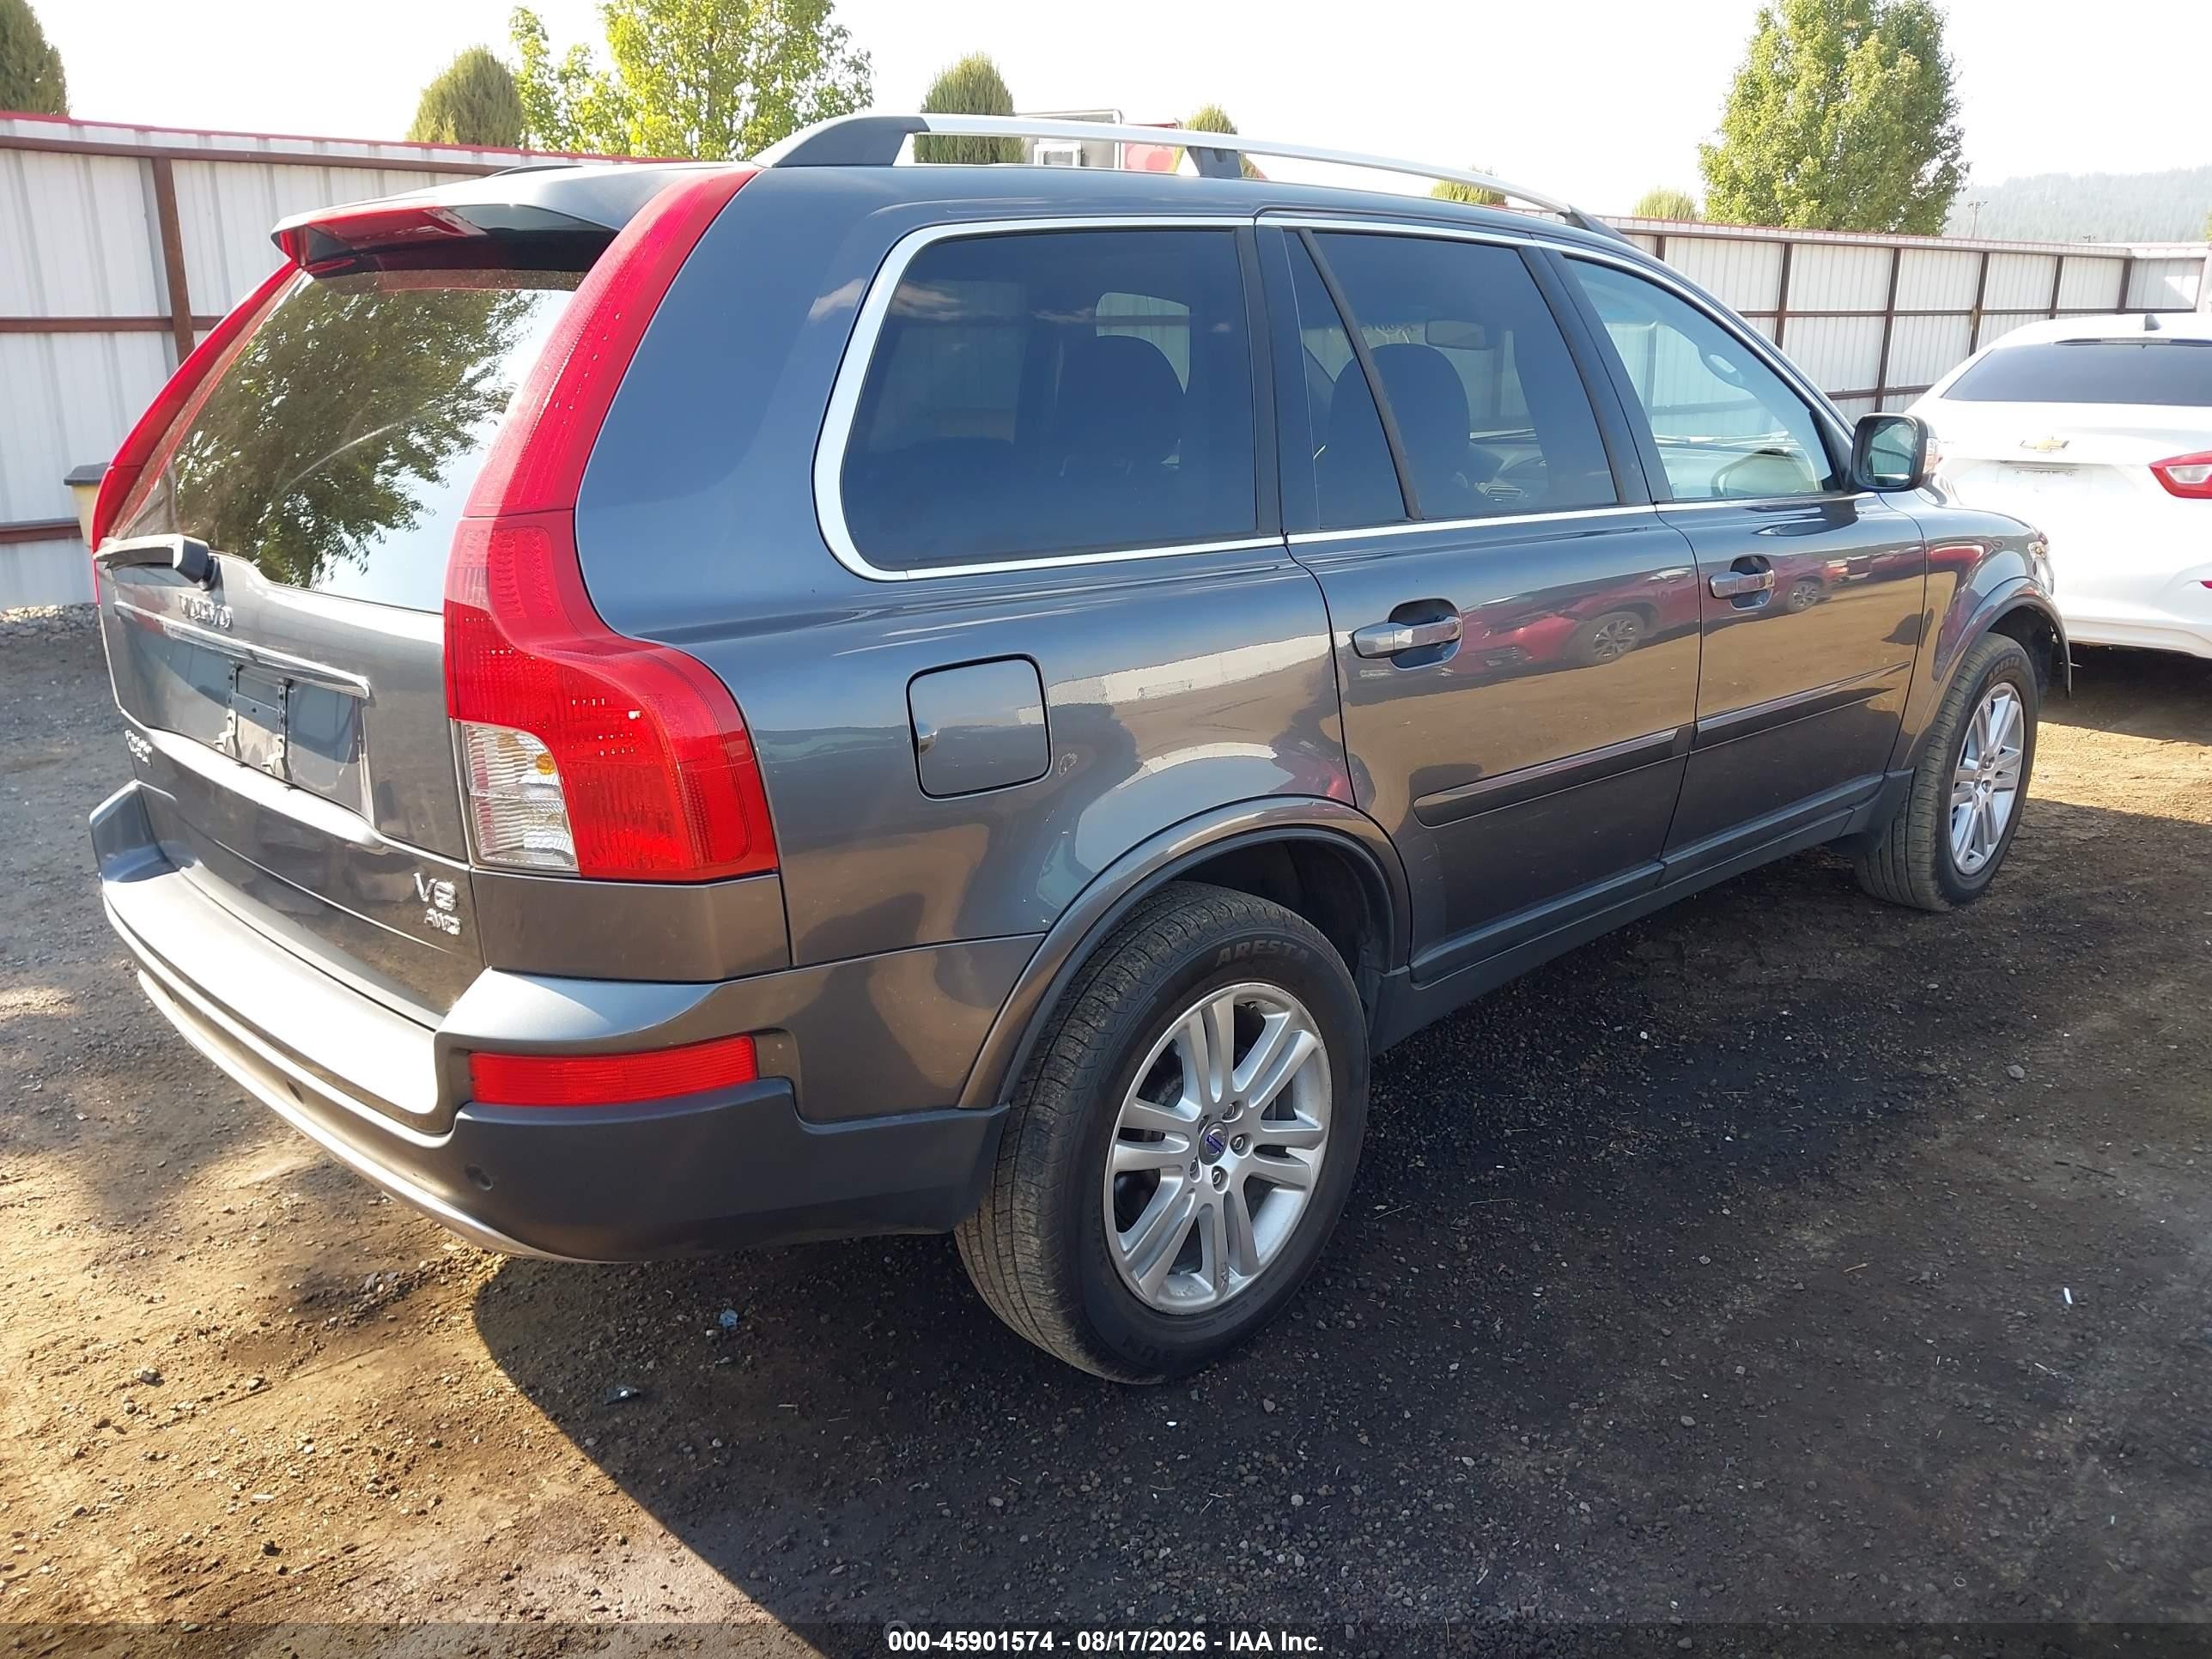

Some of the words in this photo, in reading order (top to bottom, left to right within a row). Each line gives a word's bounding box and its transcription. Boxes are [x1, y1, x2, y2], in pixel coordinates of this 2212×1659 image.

[178, 592, 234, 630] VOLVO
[412, 872, 457, 911] V8
[423, 908, 461, 936] AWD
[1215, 939, 1310, 968] ARESTA
